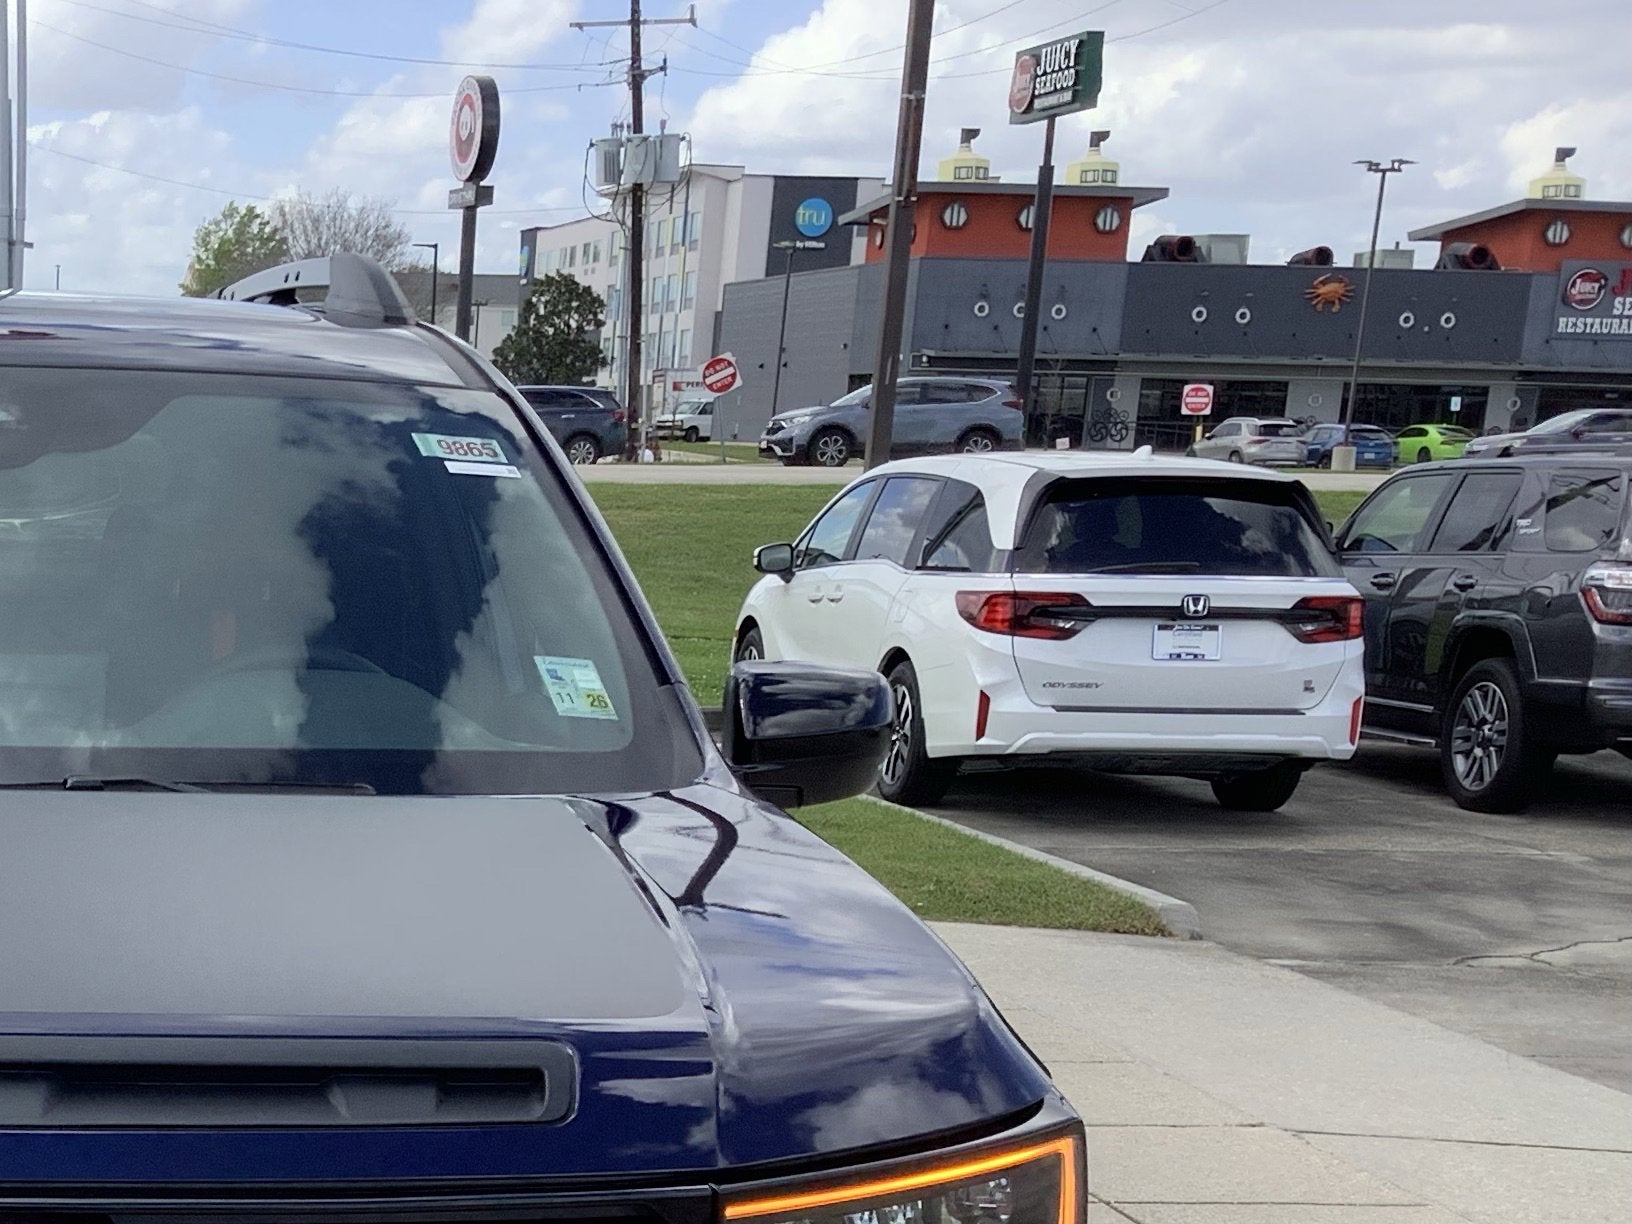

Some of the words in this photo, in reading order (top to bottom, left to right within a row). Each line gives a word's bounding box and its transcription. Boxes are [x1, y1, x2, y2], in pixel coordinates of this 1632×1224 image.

[1036, 39, 1079, 75] JUICY
[1034, 68, 1076, 95] SEAFOOD
[798, 207, 825, 226] tru
[704, 367, 715, 376] DO
[715, 360, 729, 371] NOT
[712, 376, 733, 390] ENTER
[436, 439, 499, 458] 9865
[587, 693, 608, 708] 26
